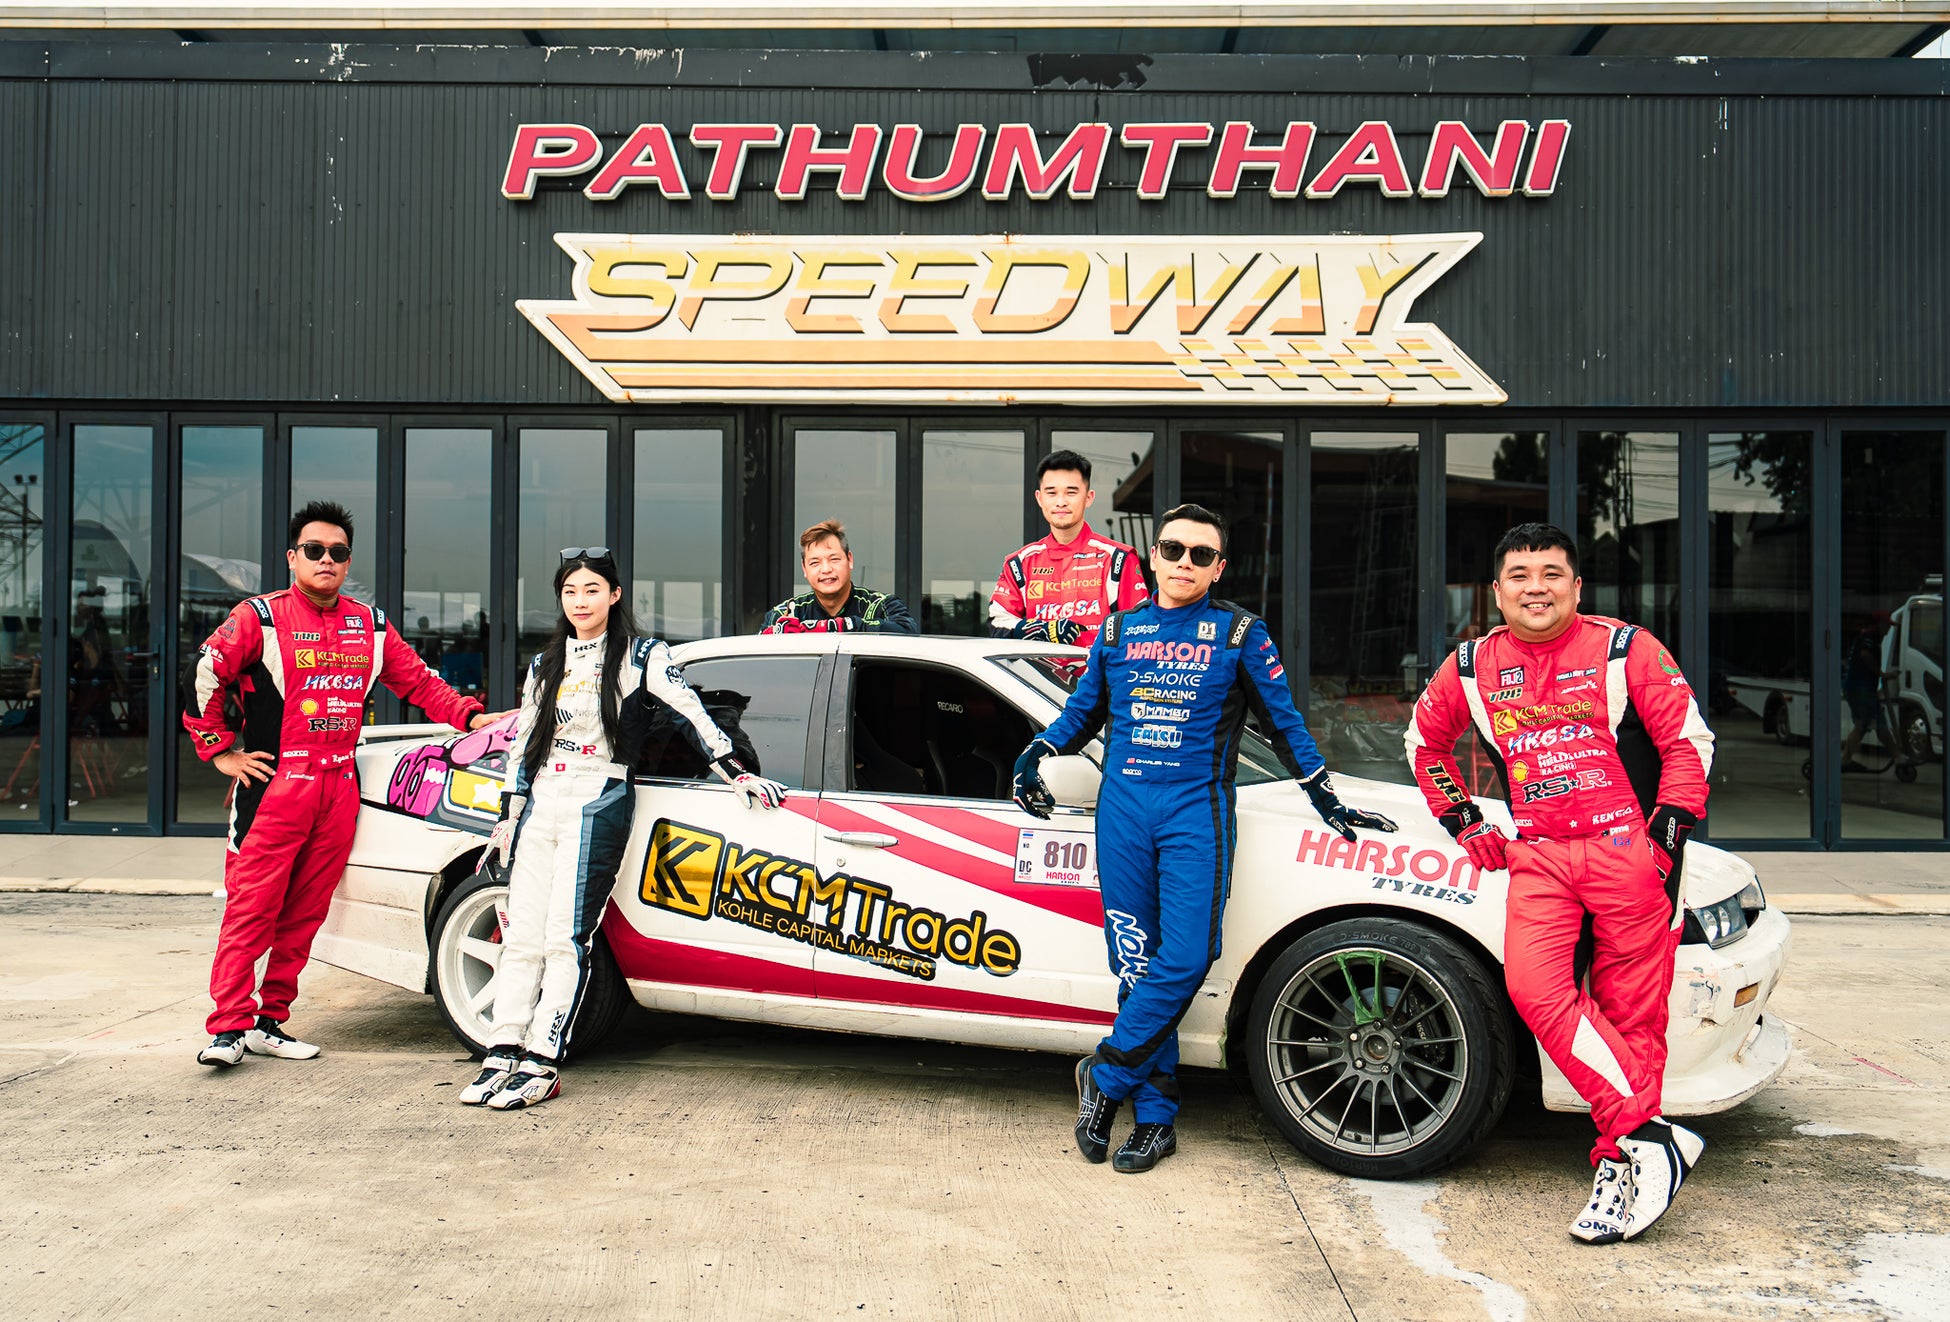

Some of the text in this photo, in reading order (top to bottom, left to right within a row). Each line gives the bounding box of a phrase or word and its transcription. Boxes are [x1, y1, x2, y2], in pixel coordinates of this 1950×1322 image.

[500, 119, 1572, 201] PATHUMTHANI
[547, 249, 1439, 336] SPEEDWAY
[1046, 577, 1103, 592] KCMTrade
[1231, 616, 1252, 646] sparco
[316, 651, 369, 663] KCMTrade
[1124, 640, 1213, 665] HARSON
[1127, 670, 1203, 687] D-SMOKE
[1156, 661, 1210, 671] TYRES
[937, 701, 964, 713] RECARO
[1515, 700, 1592, 721] KCMTrade
[1019, 860, 1032, 873] DC
[1044, 841, 1087, 870] 810
[1296, 829, 1482, 891] HARSON
[1046, 872, 1080, 881] HARSON
[1371, 876, 1477, 905] TYRES
[720, 847, 1018, 974] KCMTrade
[718, 899, 933, 977] KOHLE CAPITAL MARKETS
